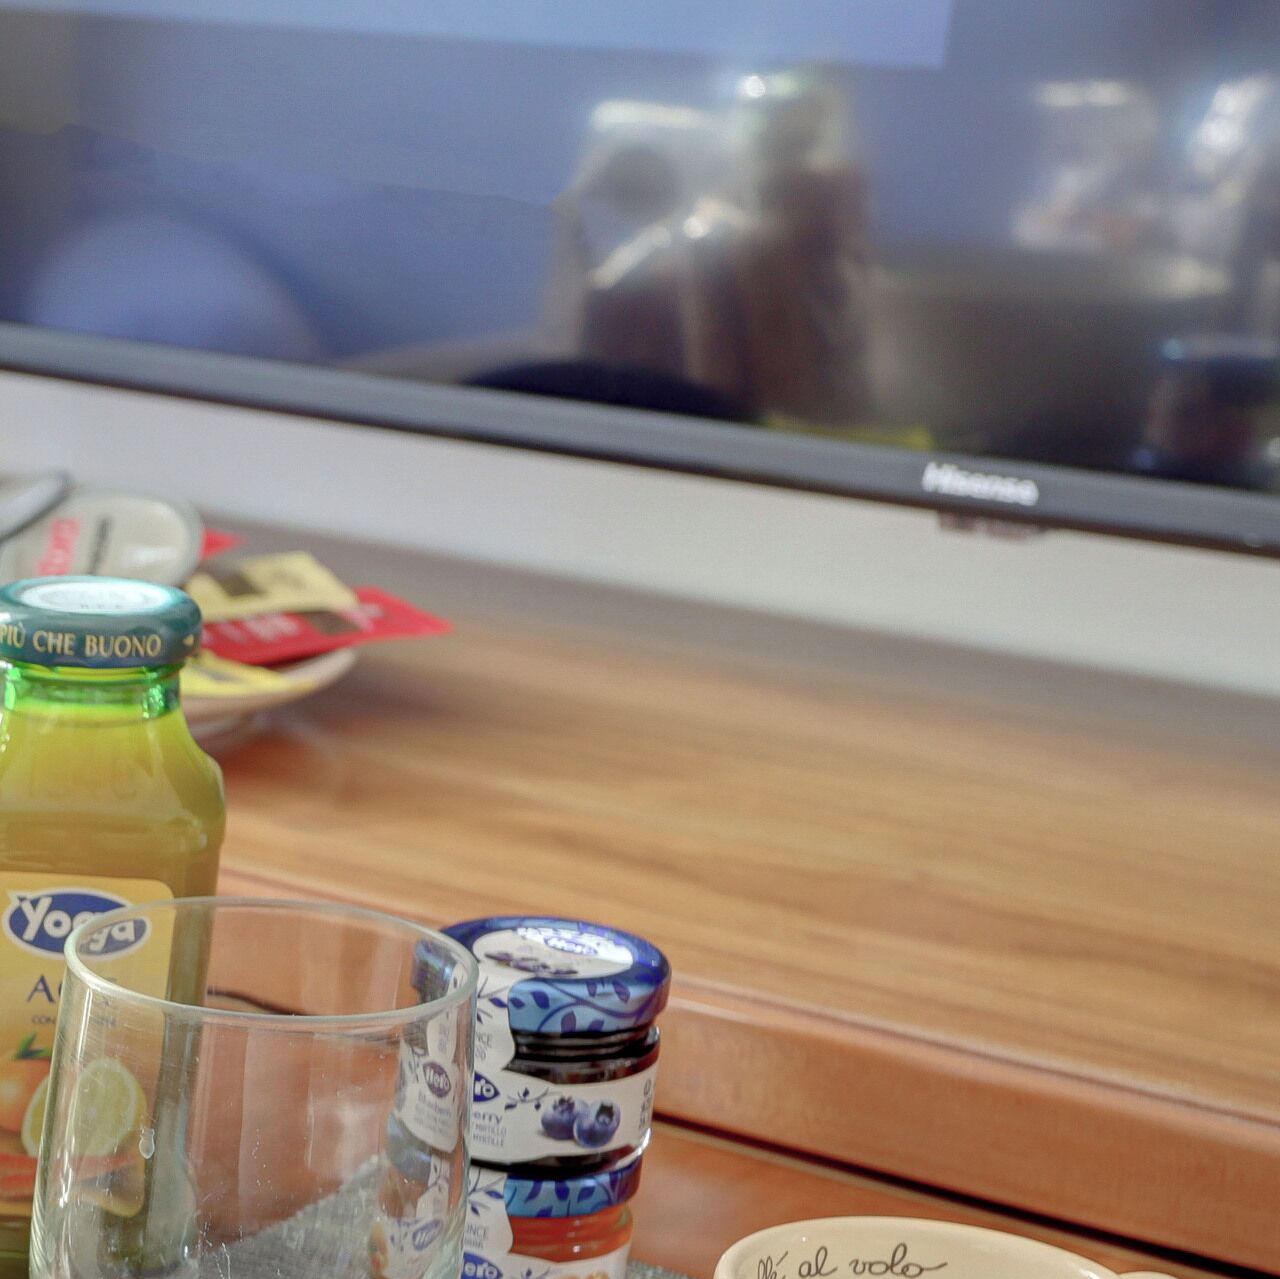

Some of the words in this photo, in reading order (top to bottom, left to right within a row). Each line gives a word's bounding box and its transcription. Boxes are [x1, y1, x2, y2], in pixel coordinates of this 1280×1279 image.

[32, 630, 76, 656] CHE
[84, 634, 162, 658] BUONO
[798, 1246, 838, 1279] al
[849, 1242, 949, 1279] volo
